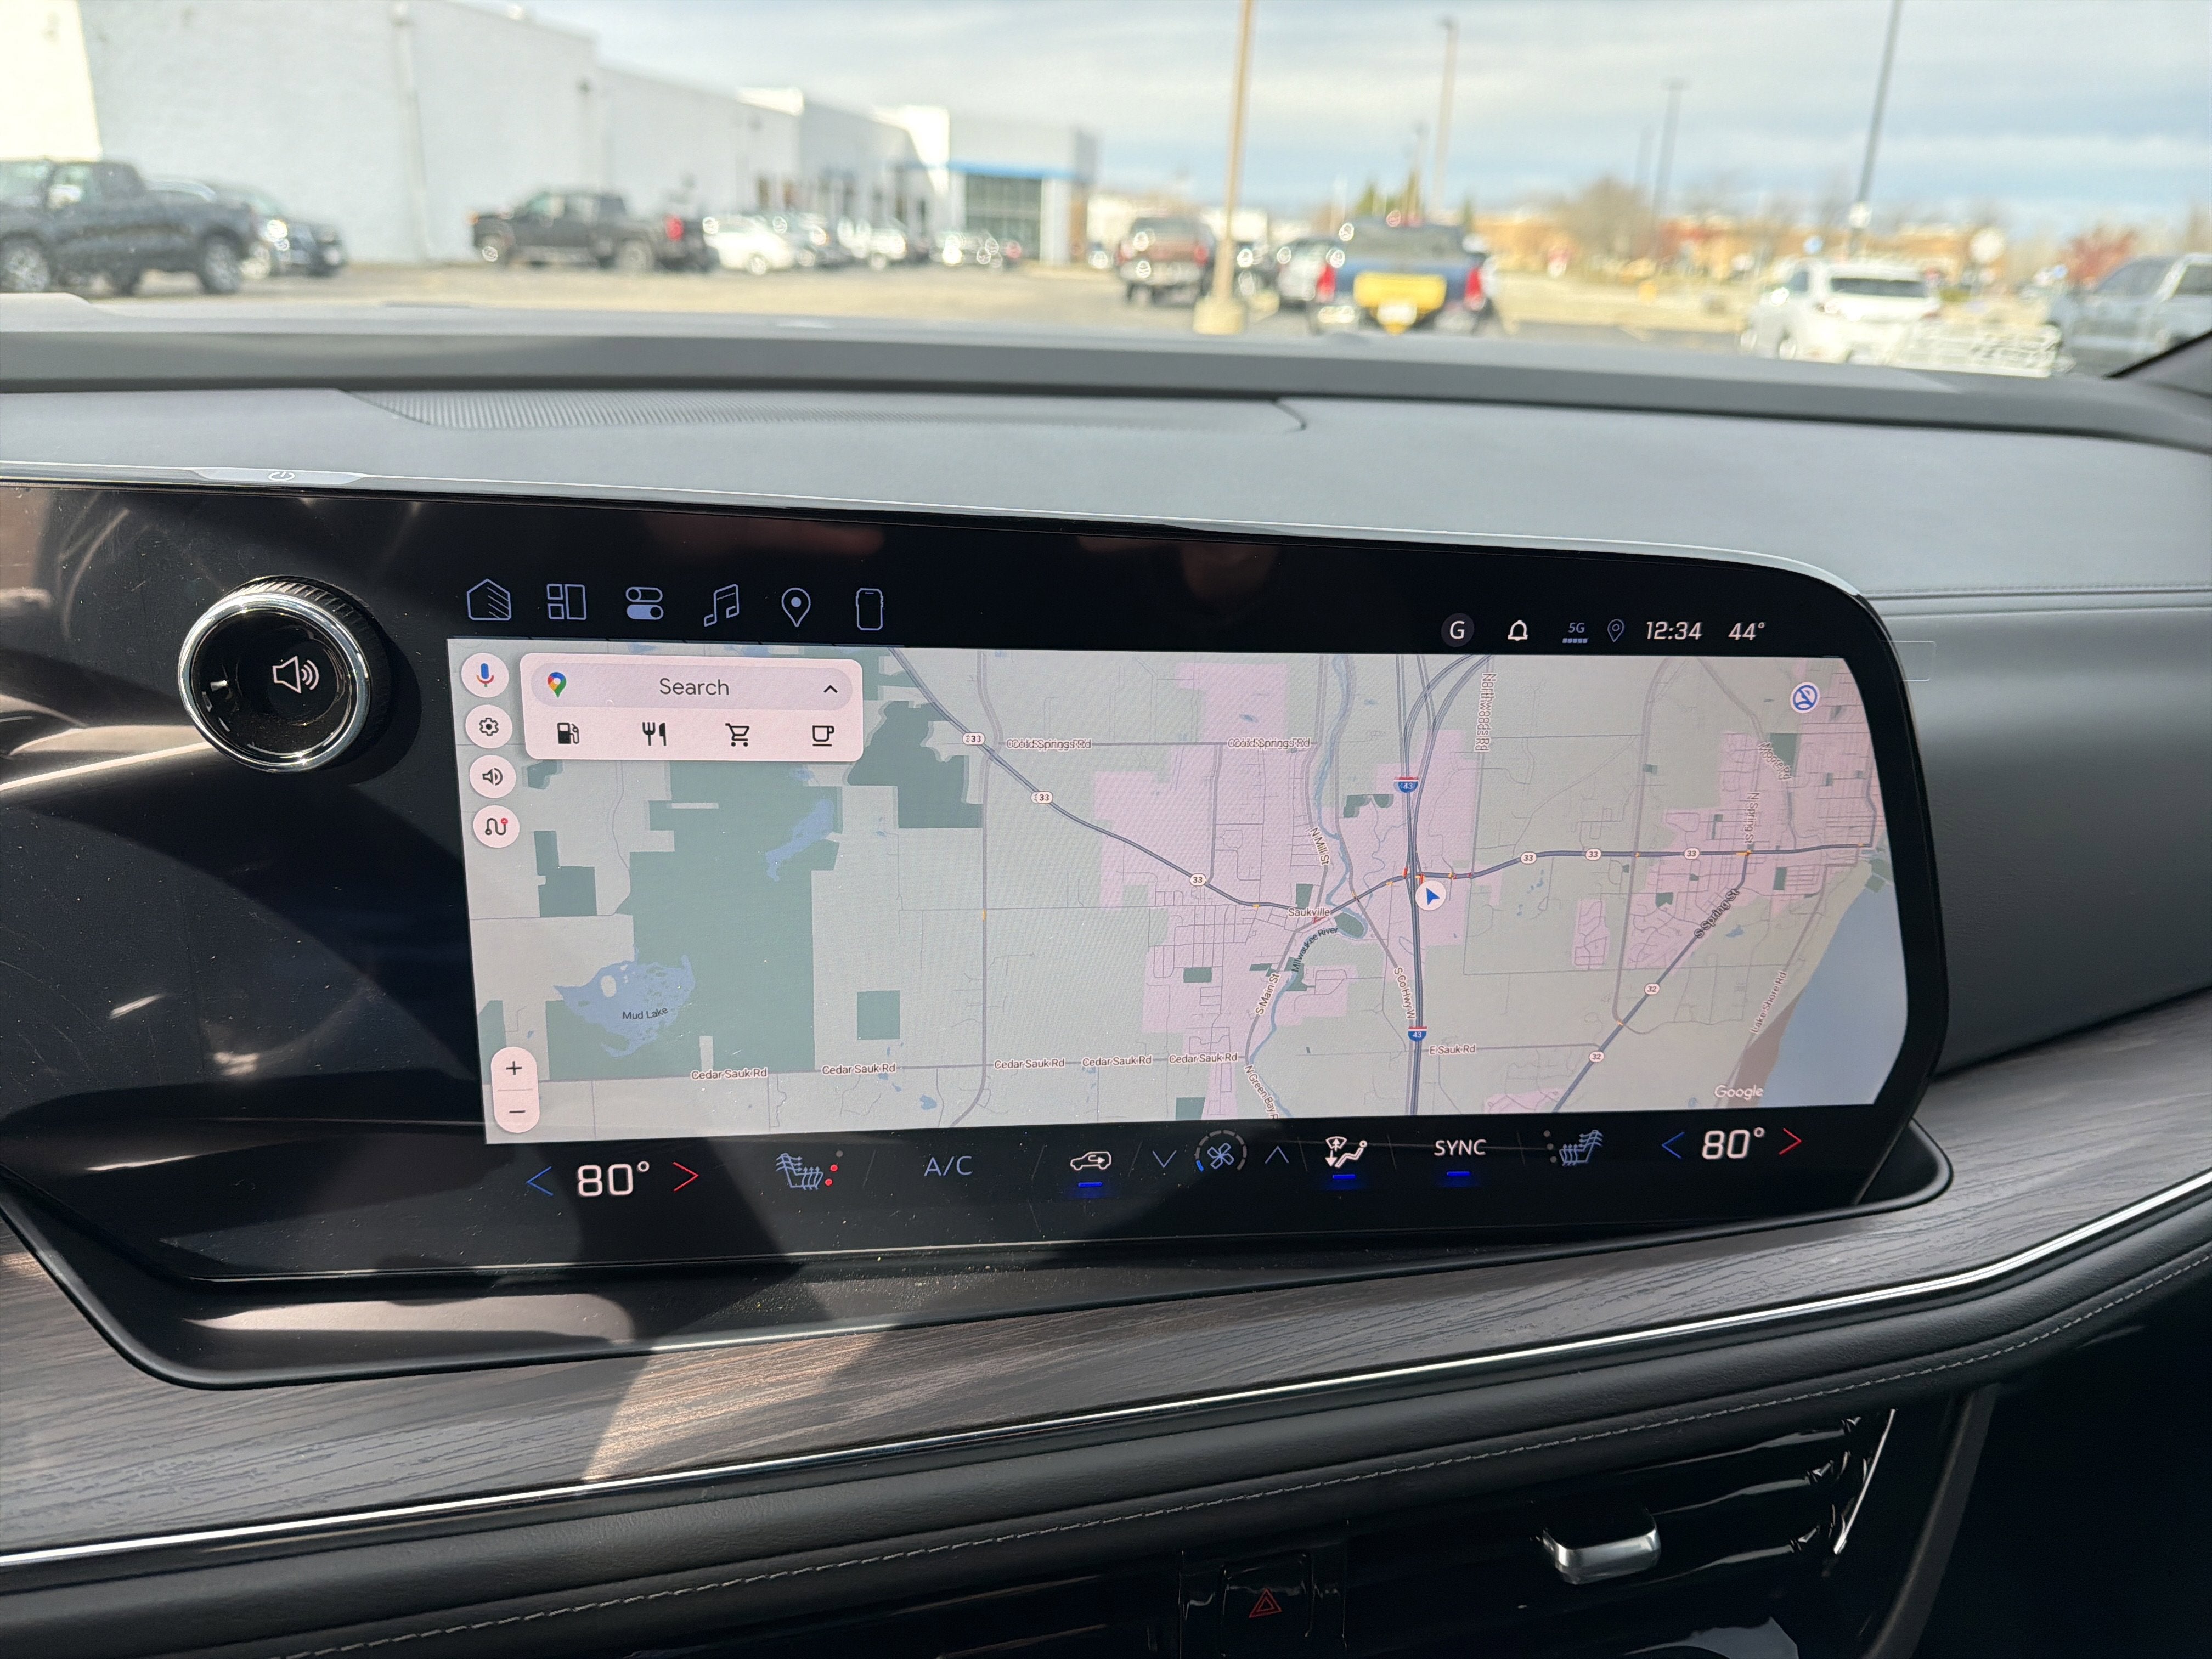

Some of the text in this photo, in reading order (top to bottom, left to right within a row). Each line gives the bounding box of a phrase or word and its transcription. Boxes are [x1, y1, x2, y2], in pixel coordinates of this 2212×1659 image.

[1449, 620, 1465, 640] G
[1568, 622, 1585, 633] 5G
[1646, 621, 1702, 640] 12:34
[1728, 621, 1765, 641] 44°
[659, 678, 729, 696] Search
[1745, 803, 1758, 832] Spring
[1310, 827, 1329, 865] N Mill St
[1745, 834, 1754, 843] St
[1288, 907, 1330, 917] Saukville
[1694, 888, 1740, 938] S Spring St
[1291, 927, 1339, 973] Milwaukee River
[1259, 985, 1274, 1007] Main
[1269, 974, 1280, 984] St
[1397, 975, 1406, 988] Co
[1401, 988, 1412, 1008] Hwy
[1751, 971, 1787, 1033] Lake Shore Rd
[622, 1007, 668, 1019] Mud Lake
[1407, 1008, 1415, 1019] W
[1169, 1052, 1238, 1063] Cedar Sauk Rd
[1430, 1044, 1476, 1054] E Sauk Rd
[822, 1063, 895, 1075] Cedar Sauk Rd
[994, 1058, 1065, 1069] Cedar Sauk Rd
[1082, 1056, 1152, 1066] Cedar Sauk Rd
[691, 1068, 767, 1080] Cedar Sauk Rd
[1244, 1065, 1254, 1074] N
[1249, 1074, 1267, 1098] Green
[1264, 1096, 1276, 1112] Bay
[1714, 1084, 1764, 1101] Google
[1434, 1139, 1487, 1156] SYNC
[1702, 1126, 1765, 1160] 80°
[924, 1155, 972, 1177] A/C
[578, 1161, 650, 1197] 80°
